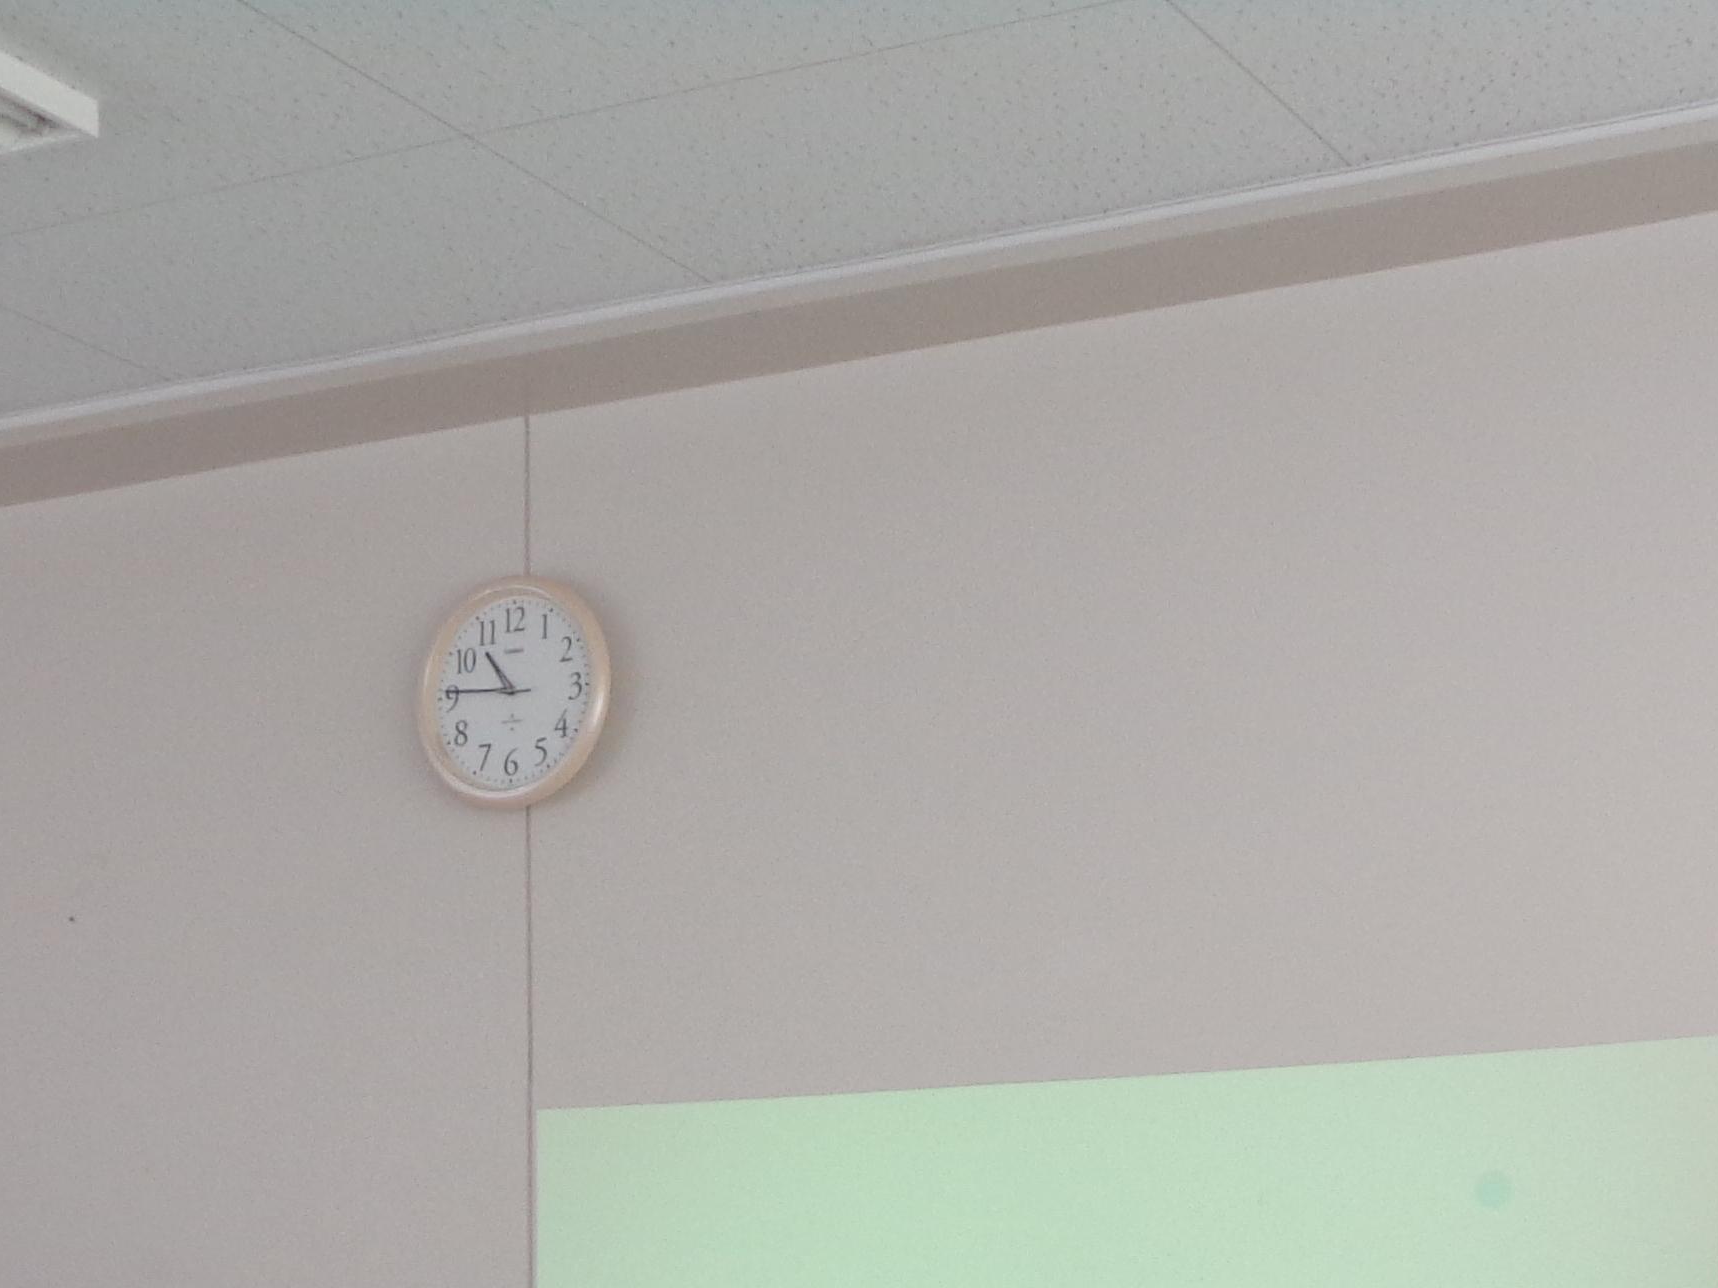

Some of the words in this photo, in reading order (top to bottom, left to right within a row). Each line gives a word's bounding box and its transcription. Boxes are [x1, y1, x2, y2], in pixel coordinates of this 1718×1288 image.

[478, 619, 497, 647] 11
[504, 606, 526, 634] 12
[541, 613, 548, 640] 1
[456, 648, 477, 675] 10
[559, 636, 574, 663] 2
[445, 684, 460, 713] 9
[568, 671, 583, 701] 3
[454, 719, 469, 747] 8
[554, 708, 569, 738] 4
[478, 743, 492, 772] 7
[503, 748, 519, 777] 6
[534, 737, 548, 767] 5
